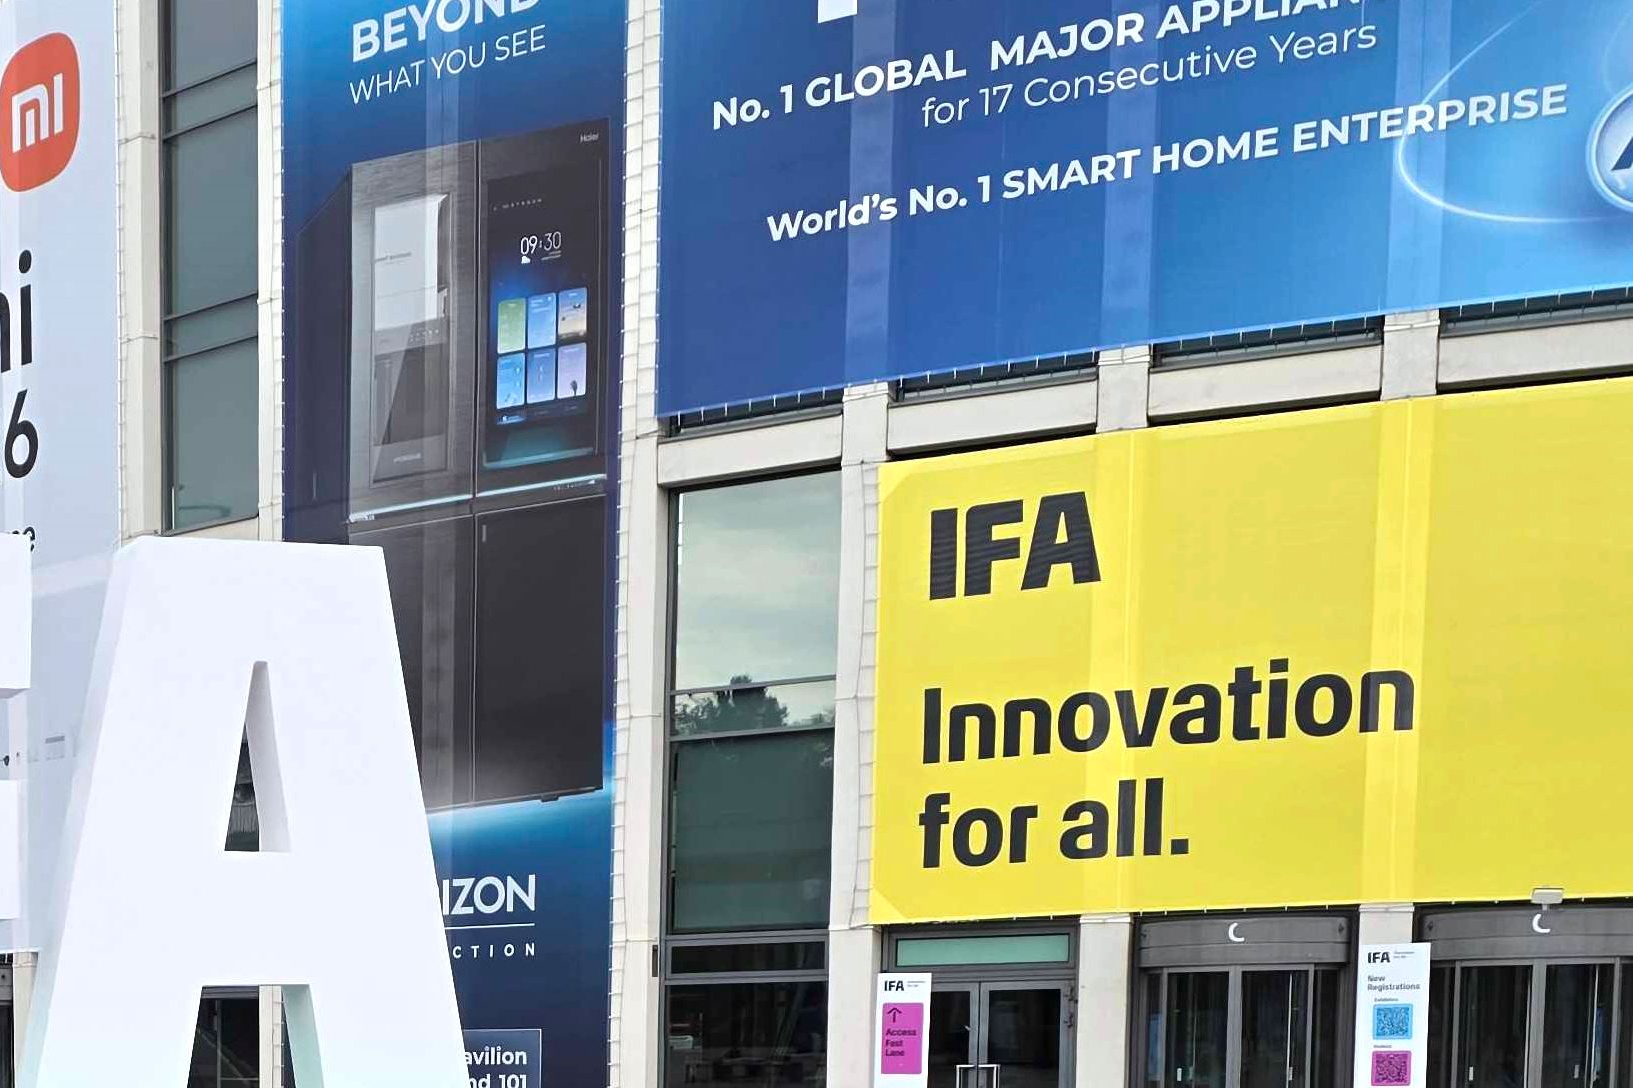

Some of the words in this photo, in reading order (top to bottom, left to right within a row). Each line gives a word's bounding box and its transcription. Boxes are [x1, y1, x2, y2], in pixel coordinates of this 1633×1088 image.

[350, 59, 425, 104] WHAT
[431, 42, 486, 79] YOU
[495, 24, 546, 61] SEE
[712, 96, 770, 130] No.
[779, 85, 793, 114] 1
[805, 49, 967, 107] GLOBAL
[991, 12, 1144, 71] MAJOR
[921, 95, 969, 127] for
[978, 84, 1013, 116] 17
[1024, 43, 1257, 107] Consecutive
[1269, 25, 1377, 63] Years
[767, 193, 898, 242] World’s
[909, 185, 968, 216] No.
[977, 175, 991, 203] 1
[1002, 149, 1142, 199] SMART
[1152, 127, 1279, 174] HOME
[1294, 84, 1568, 153] ENTERPRISE
[929, 491, 1102, 601] IFA
[922, 658, 1415, 765] Innovation
[918, 792, 1039, 869] for
[1059, 777, 1189, 861] all.
[884, 980, 904, 991] IFA
[1367, 951, 1390, 963] IFA
